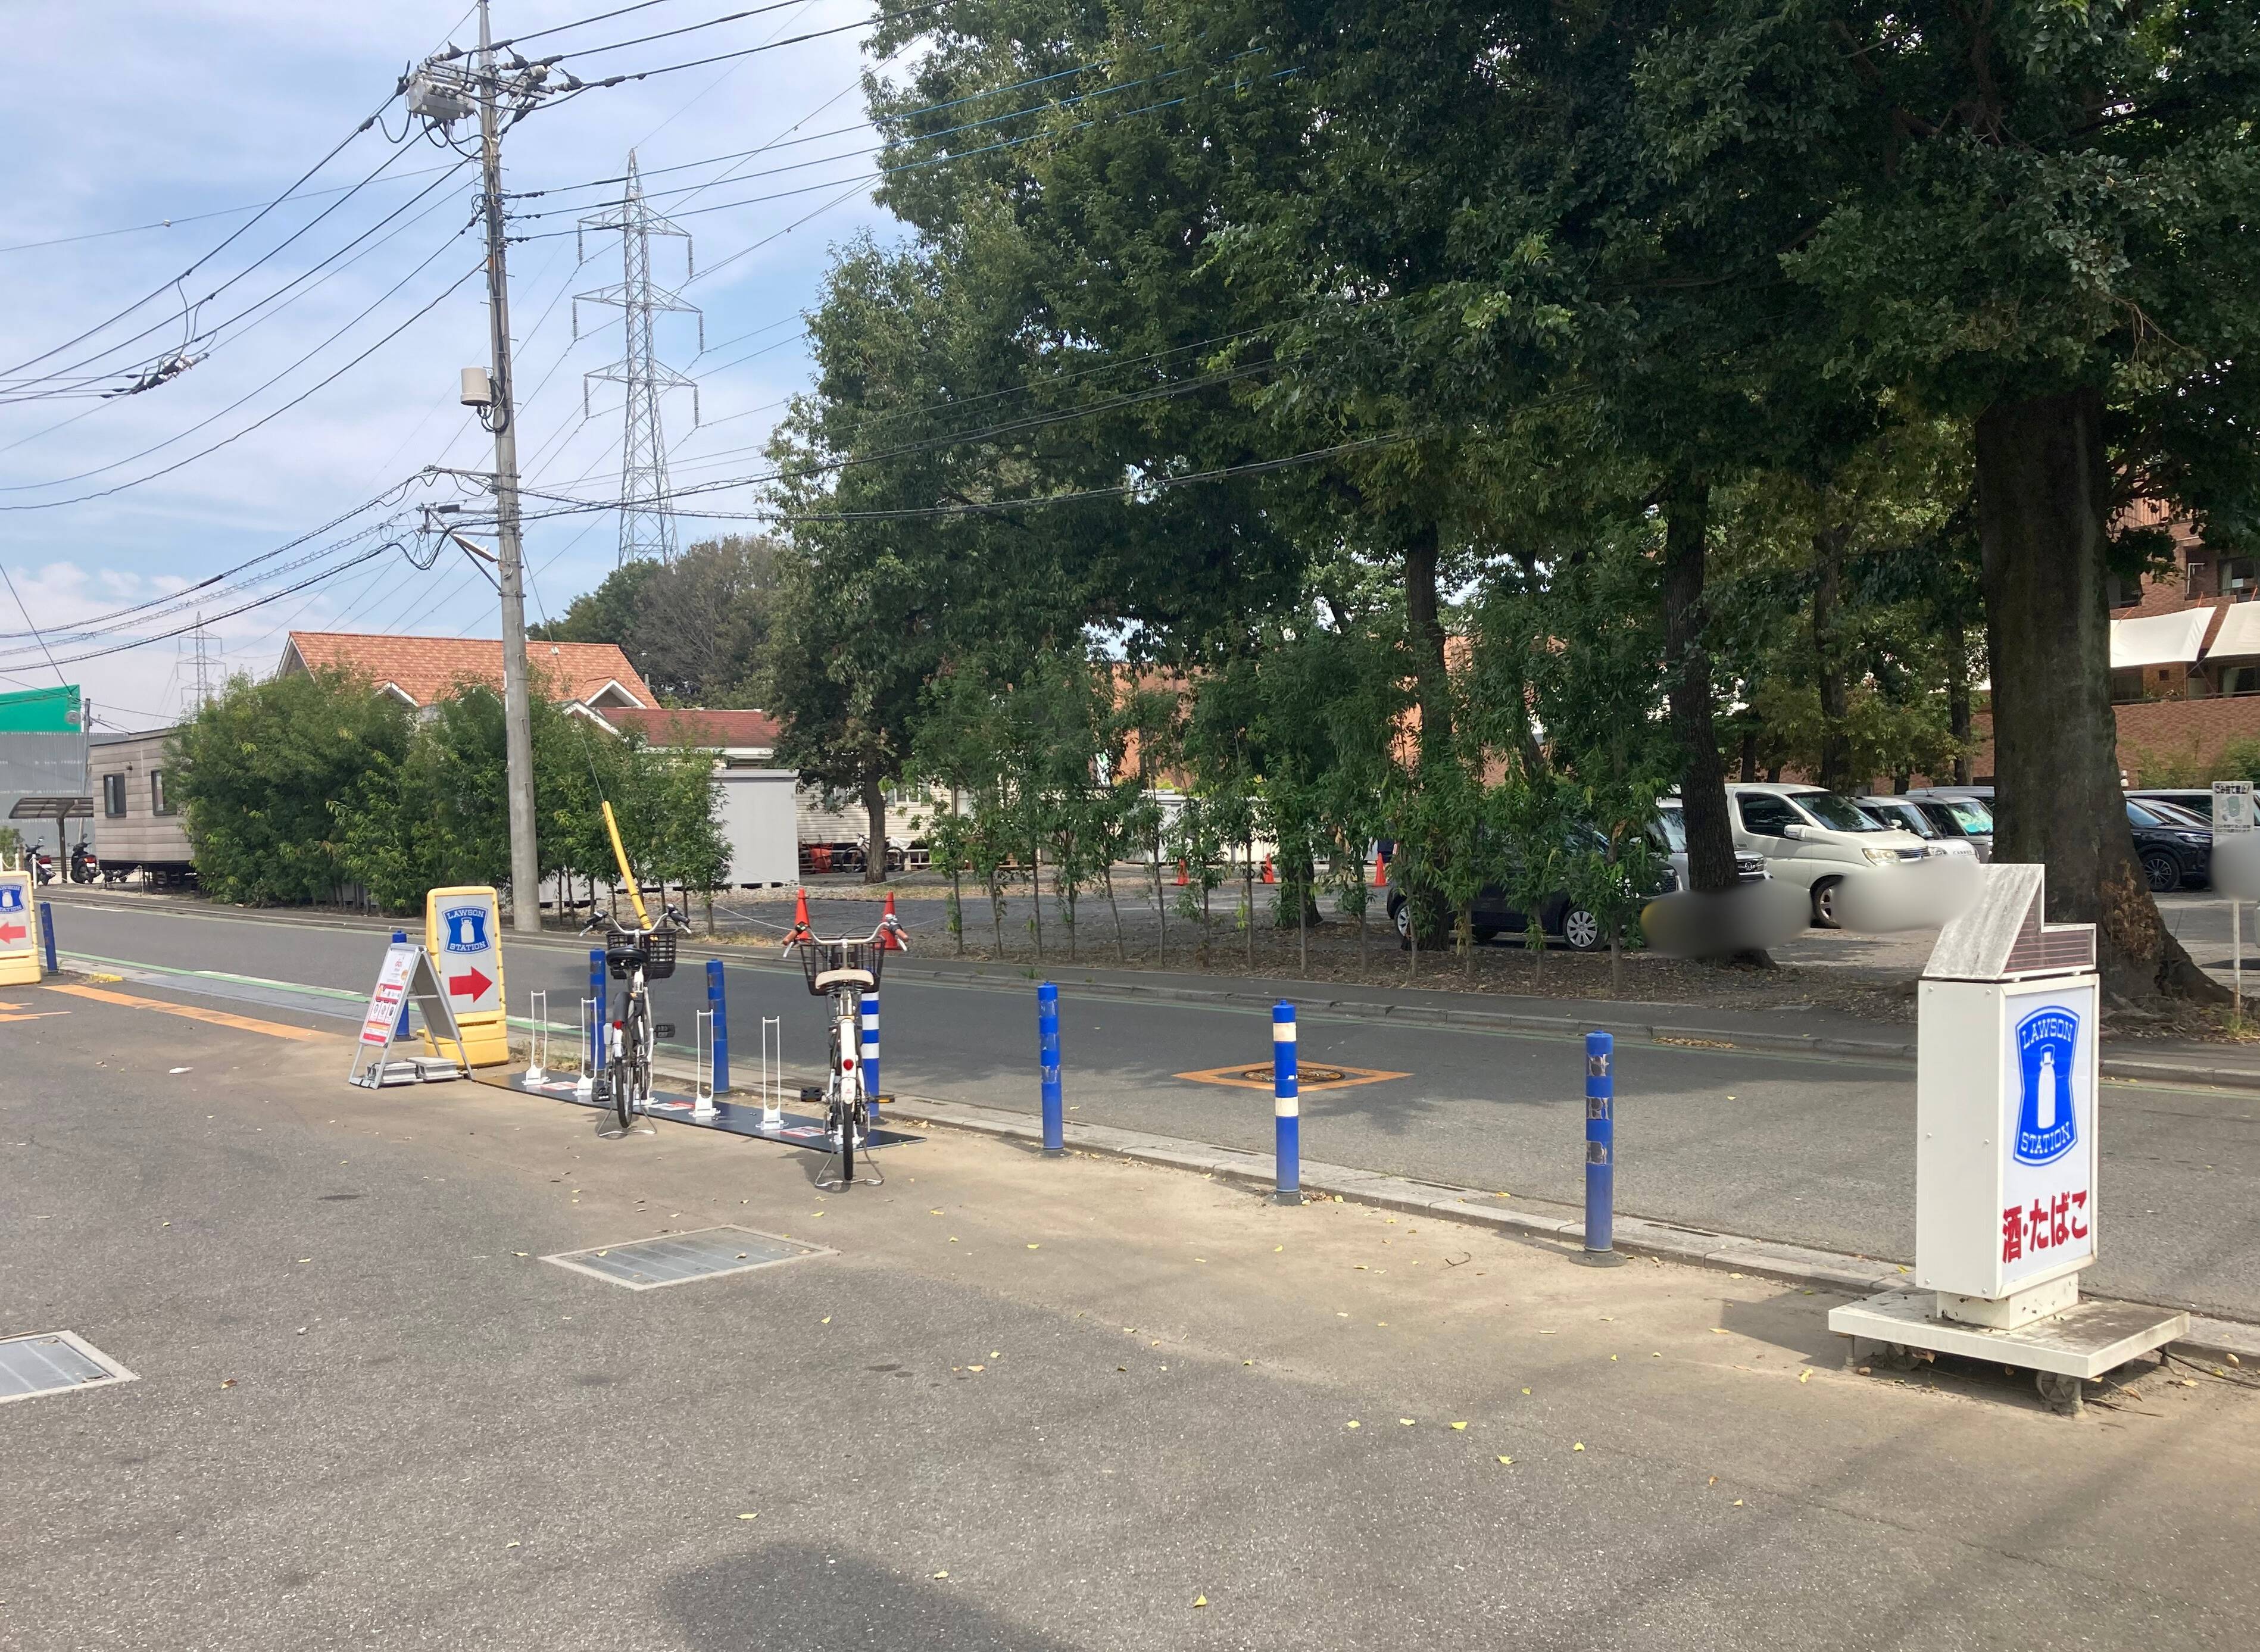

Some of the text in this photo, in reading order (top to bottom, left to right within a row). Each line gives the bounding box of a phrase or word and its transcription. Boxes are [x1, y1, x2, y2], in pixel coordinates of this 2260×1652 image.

[447, 908, 485, 920] LAWSON
[449, 941, 486, 951] STATION
[2022, 1017, 2073, 1051] LAWSON
[2021, 1120, 2071, 1154] STATION
[2003, 1189, 2088, 1263] 酒・たばこ
